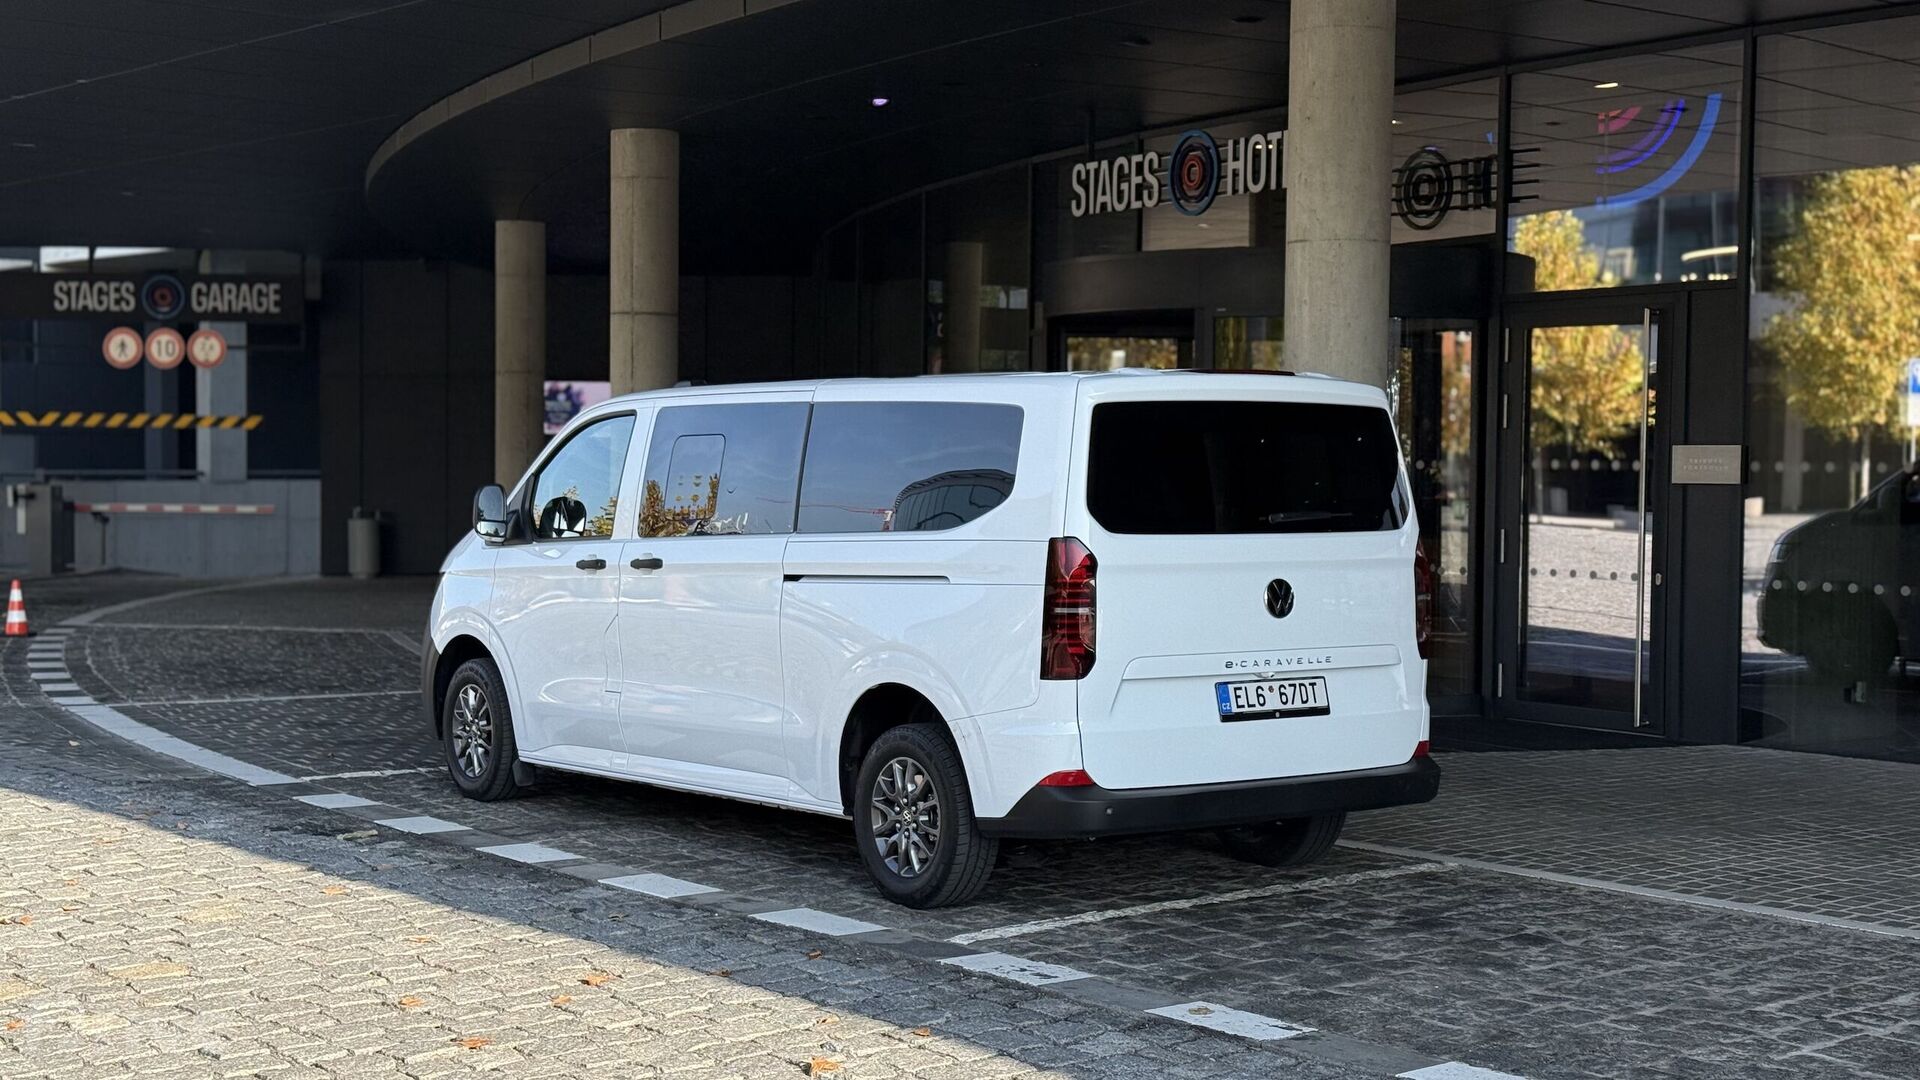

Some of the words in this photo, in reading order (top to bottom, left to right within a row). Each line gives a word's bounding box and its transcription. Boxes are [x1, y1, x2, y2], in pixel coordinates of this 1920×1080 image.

[1071, 151, 1159, 217] STAGES
[1226, 130, 1288, 196] HOT
[53, 281, 136, 312] STAGES
[190, 283, 281, 313] GARAGE
[156, 339, 176, 358] 10
[1222, 702, 1232, 710] CZ
[1233, 685, 1266, 709] EL6
[1278, 682, 1317, 705] 67DT
